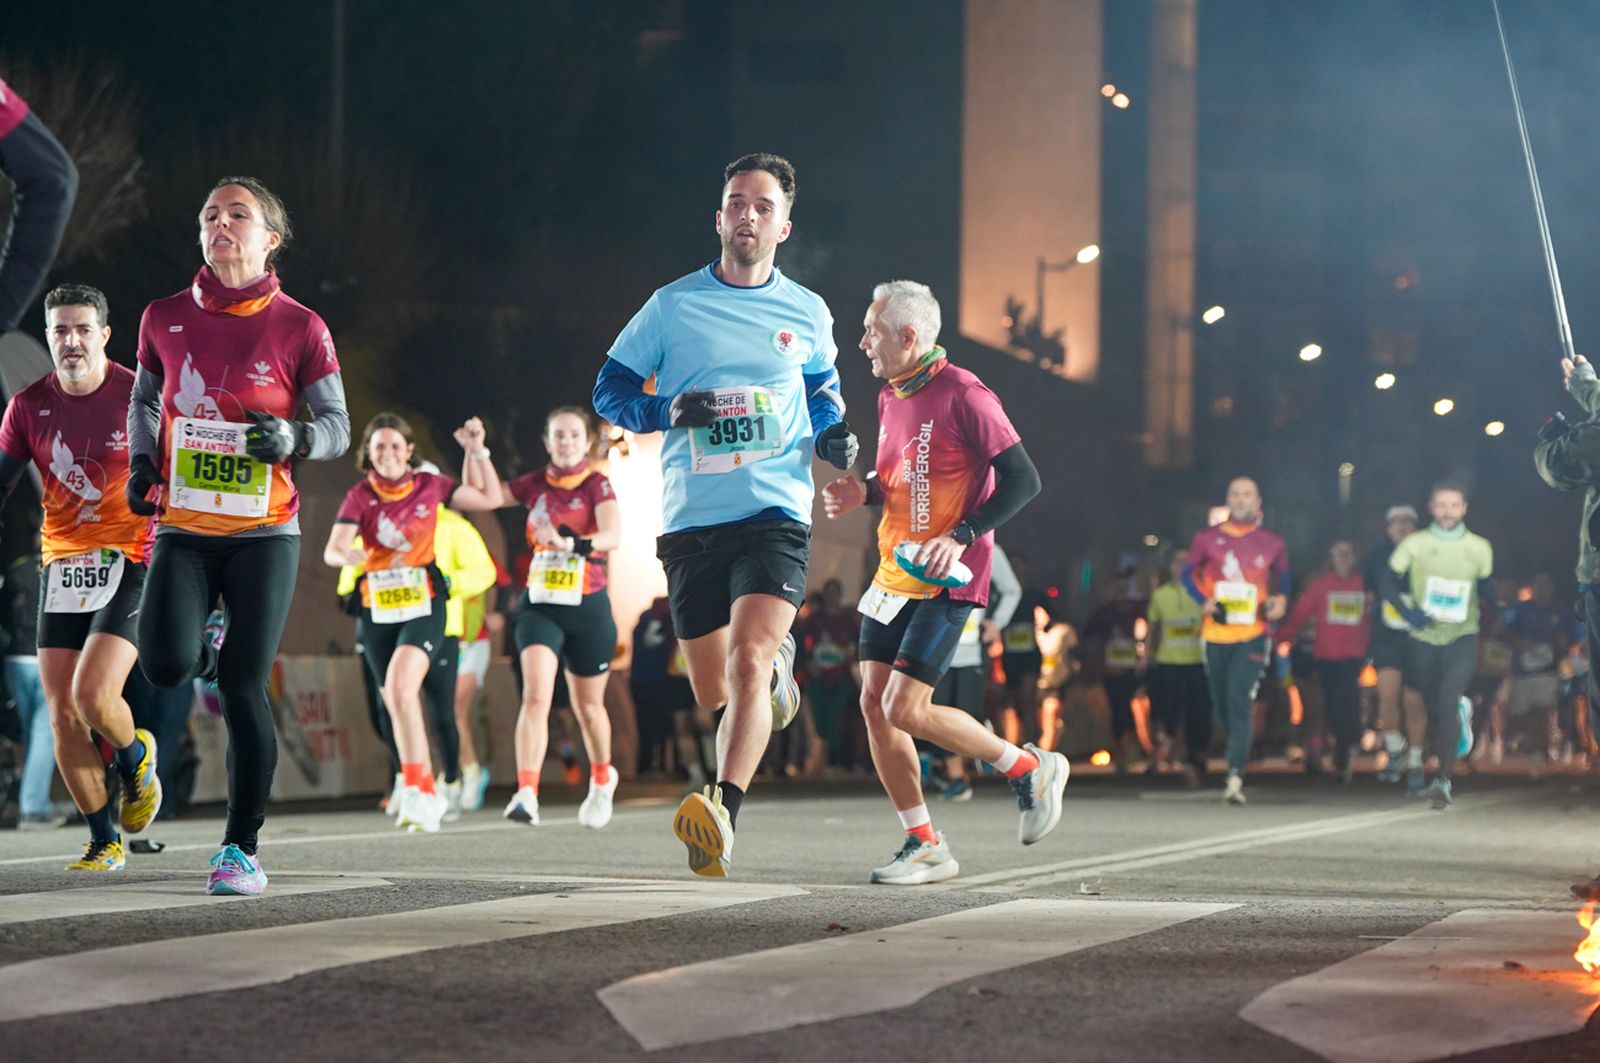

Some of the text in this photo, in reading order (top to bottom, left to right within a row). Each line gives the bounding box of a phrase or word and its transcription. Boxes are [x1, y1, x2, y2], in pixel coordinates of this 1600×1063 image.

[735, 395, 746, 405] DE
[226, 432, 239, 442] DE
[707, 416, 766, 446] 3931
[184, 438, 203, 450] SAN
[191, 452, 252, 485] 1595
[916, 419, 934, 532] TORREPEROGIL
[66, 470, 85, 490] 43
[62, 566, 110, 589] 5659
